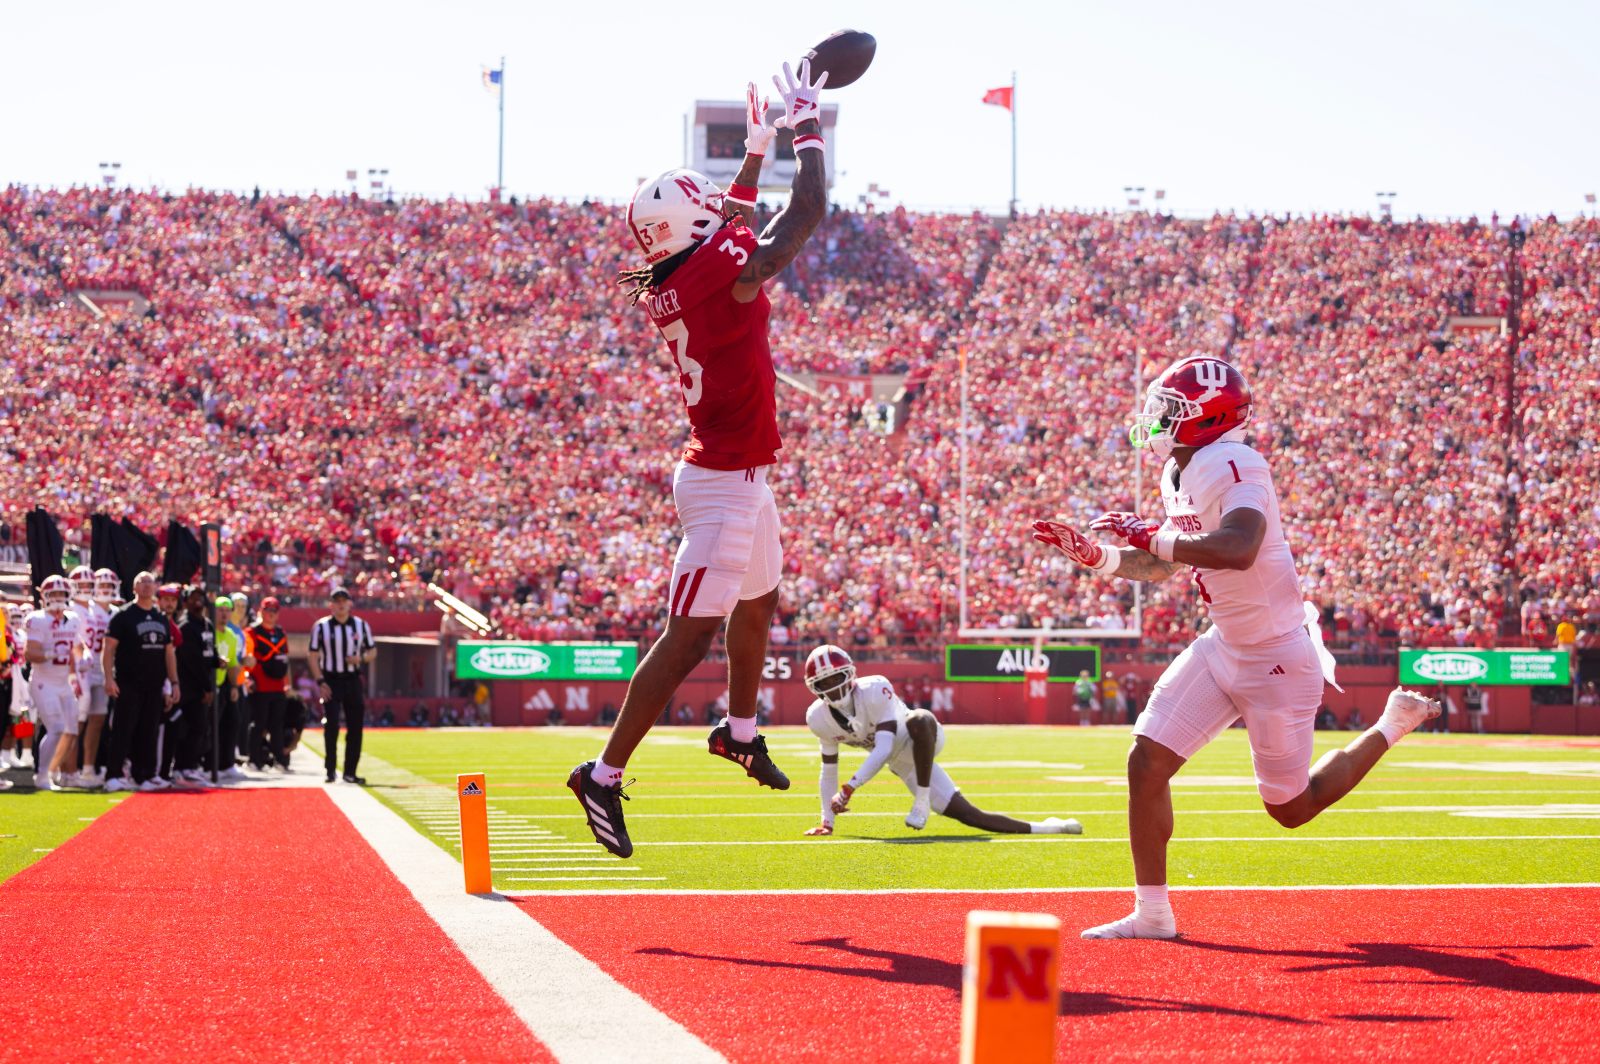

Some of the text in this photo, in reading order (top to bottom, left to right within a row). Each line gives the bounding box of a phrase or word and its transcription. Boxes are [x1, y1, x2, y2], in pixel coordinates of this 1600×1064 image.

[674, 176, 701, 198] N
[640, 228, 654, 246] 3
[719, 239, 748, 266] 3
[660, 318, 704, 407] 3
[1228, 460, 1242, 483] 1
[478, 648, 543, 671] Sukup
[1421, 654, 1482, 676] Sukup
[565, 687, 589, 711] N
[986, 945, 1052, 1003] N
